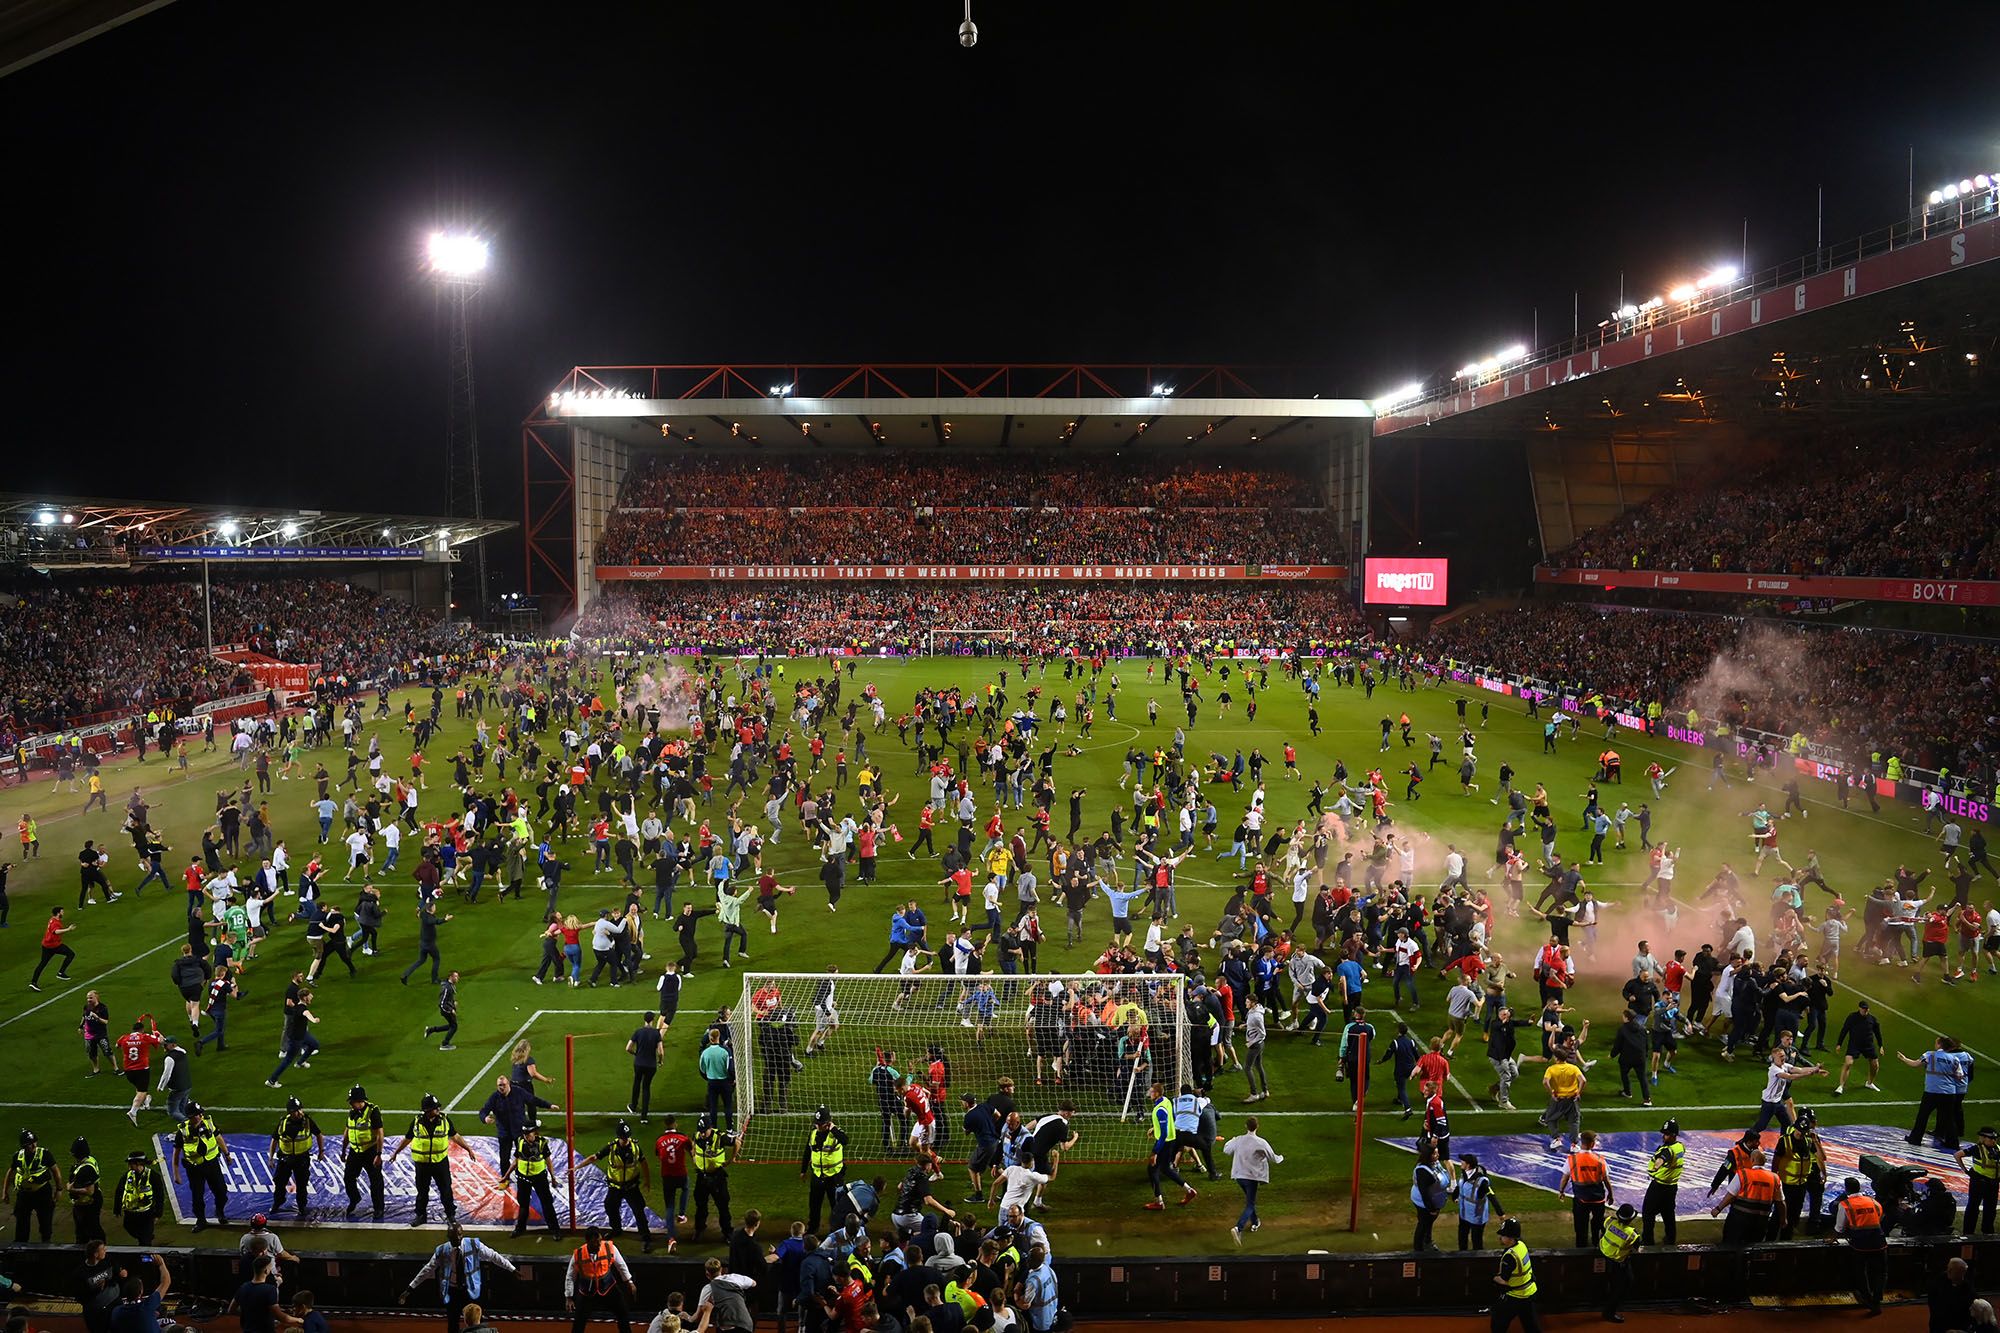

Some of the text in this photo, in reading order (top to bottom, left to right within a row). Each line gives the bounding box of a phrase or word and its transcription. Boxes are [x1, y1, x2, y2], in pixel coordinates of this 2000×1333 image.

[1503, 350, 1599, 398] BRIAN
[1644, 267, 1857, 356] CLOUGH
[709, 568, 1226, 577] THE GARIBALDI THAT WE WEAR WITH PRIDE WAS MADE IN 1865
[1912, 583, 1958, 600] BOXT
[1482, 679, 1504, 693] BOILERS
[1667, 725, 1704, 746] BOILERS
[232, 914, 244, 926] 18
[129, 1047, 139, 1061] 8
[666, 1145, 676, 1164] 3
